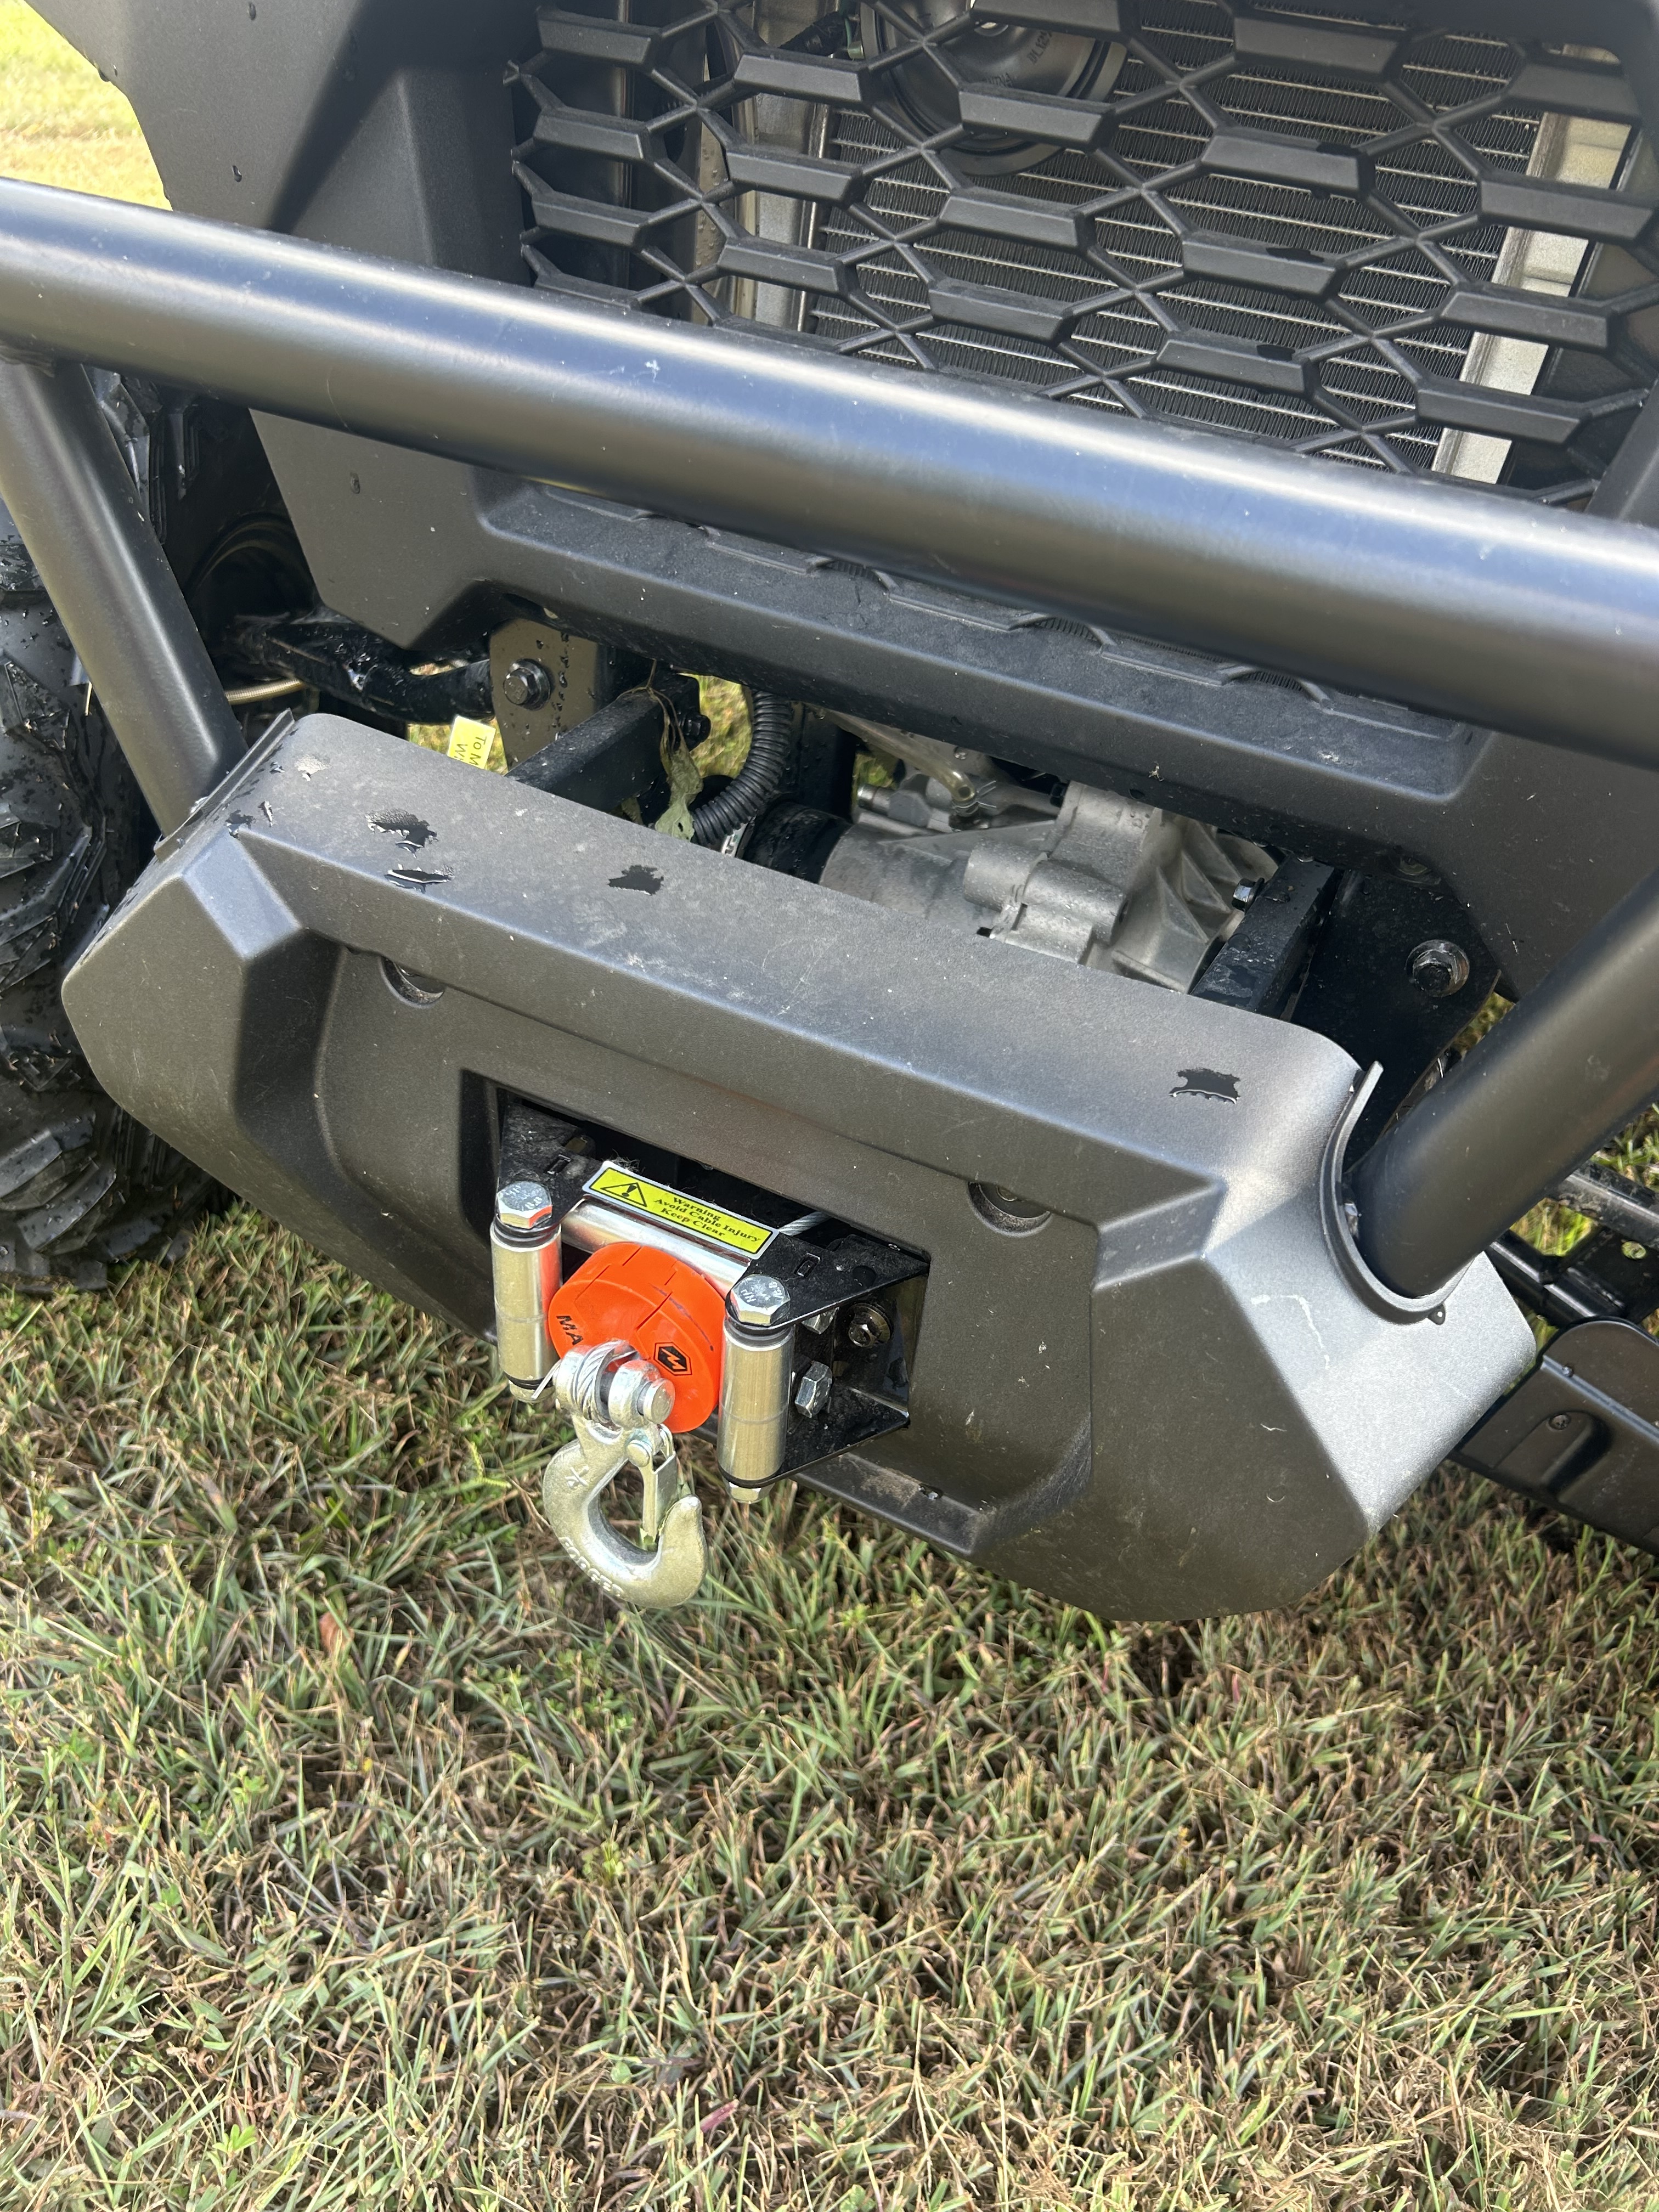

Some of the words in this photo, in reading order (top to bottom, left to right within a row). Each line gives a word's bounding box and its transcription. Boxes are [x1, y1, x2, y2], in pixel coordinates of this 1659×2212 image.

[653, 1199, 689, 1214] Avoid
[689, 1211, 721, 1229] Cable
[723, 1224, 761, 1243] Injury
[661, 1208, 691, 1223] Keep
[693, 1220, 725, 1237] Clear
[673, 1197, 721, 1221] Warning
